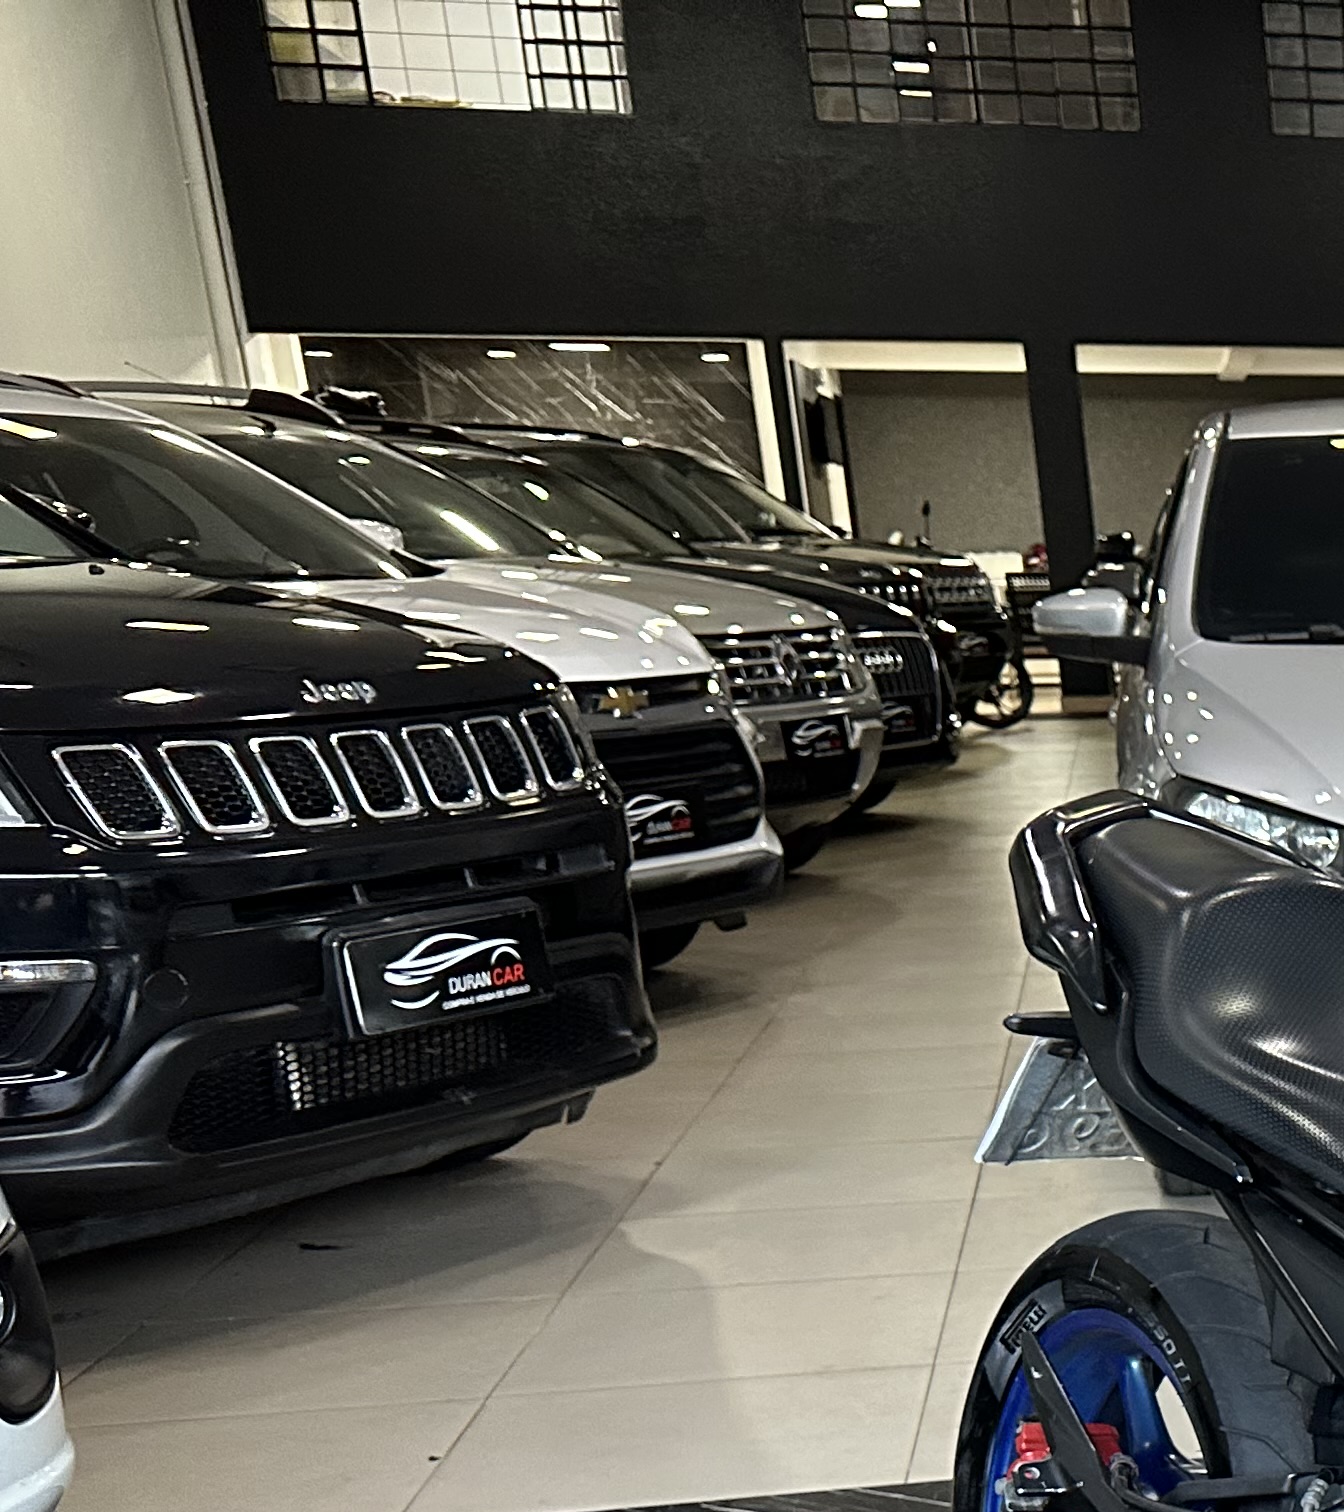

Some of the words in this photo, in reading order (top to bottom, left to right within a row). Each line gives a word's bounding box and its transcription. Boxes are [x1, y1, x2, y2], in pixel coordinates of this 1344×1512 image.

[300, 679, 377, 704] Jeep
[448, 970, 491, 995] DURAN
[492, 963, 526, 987] CAR
